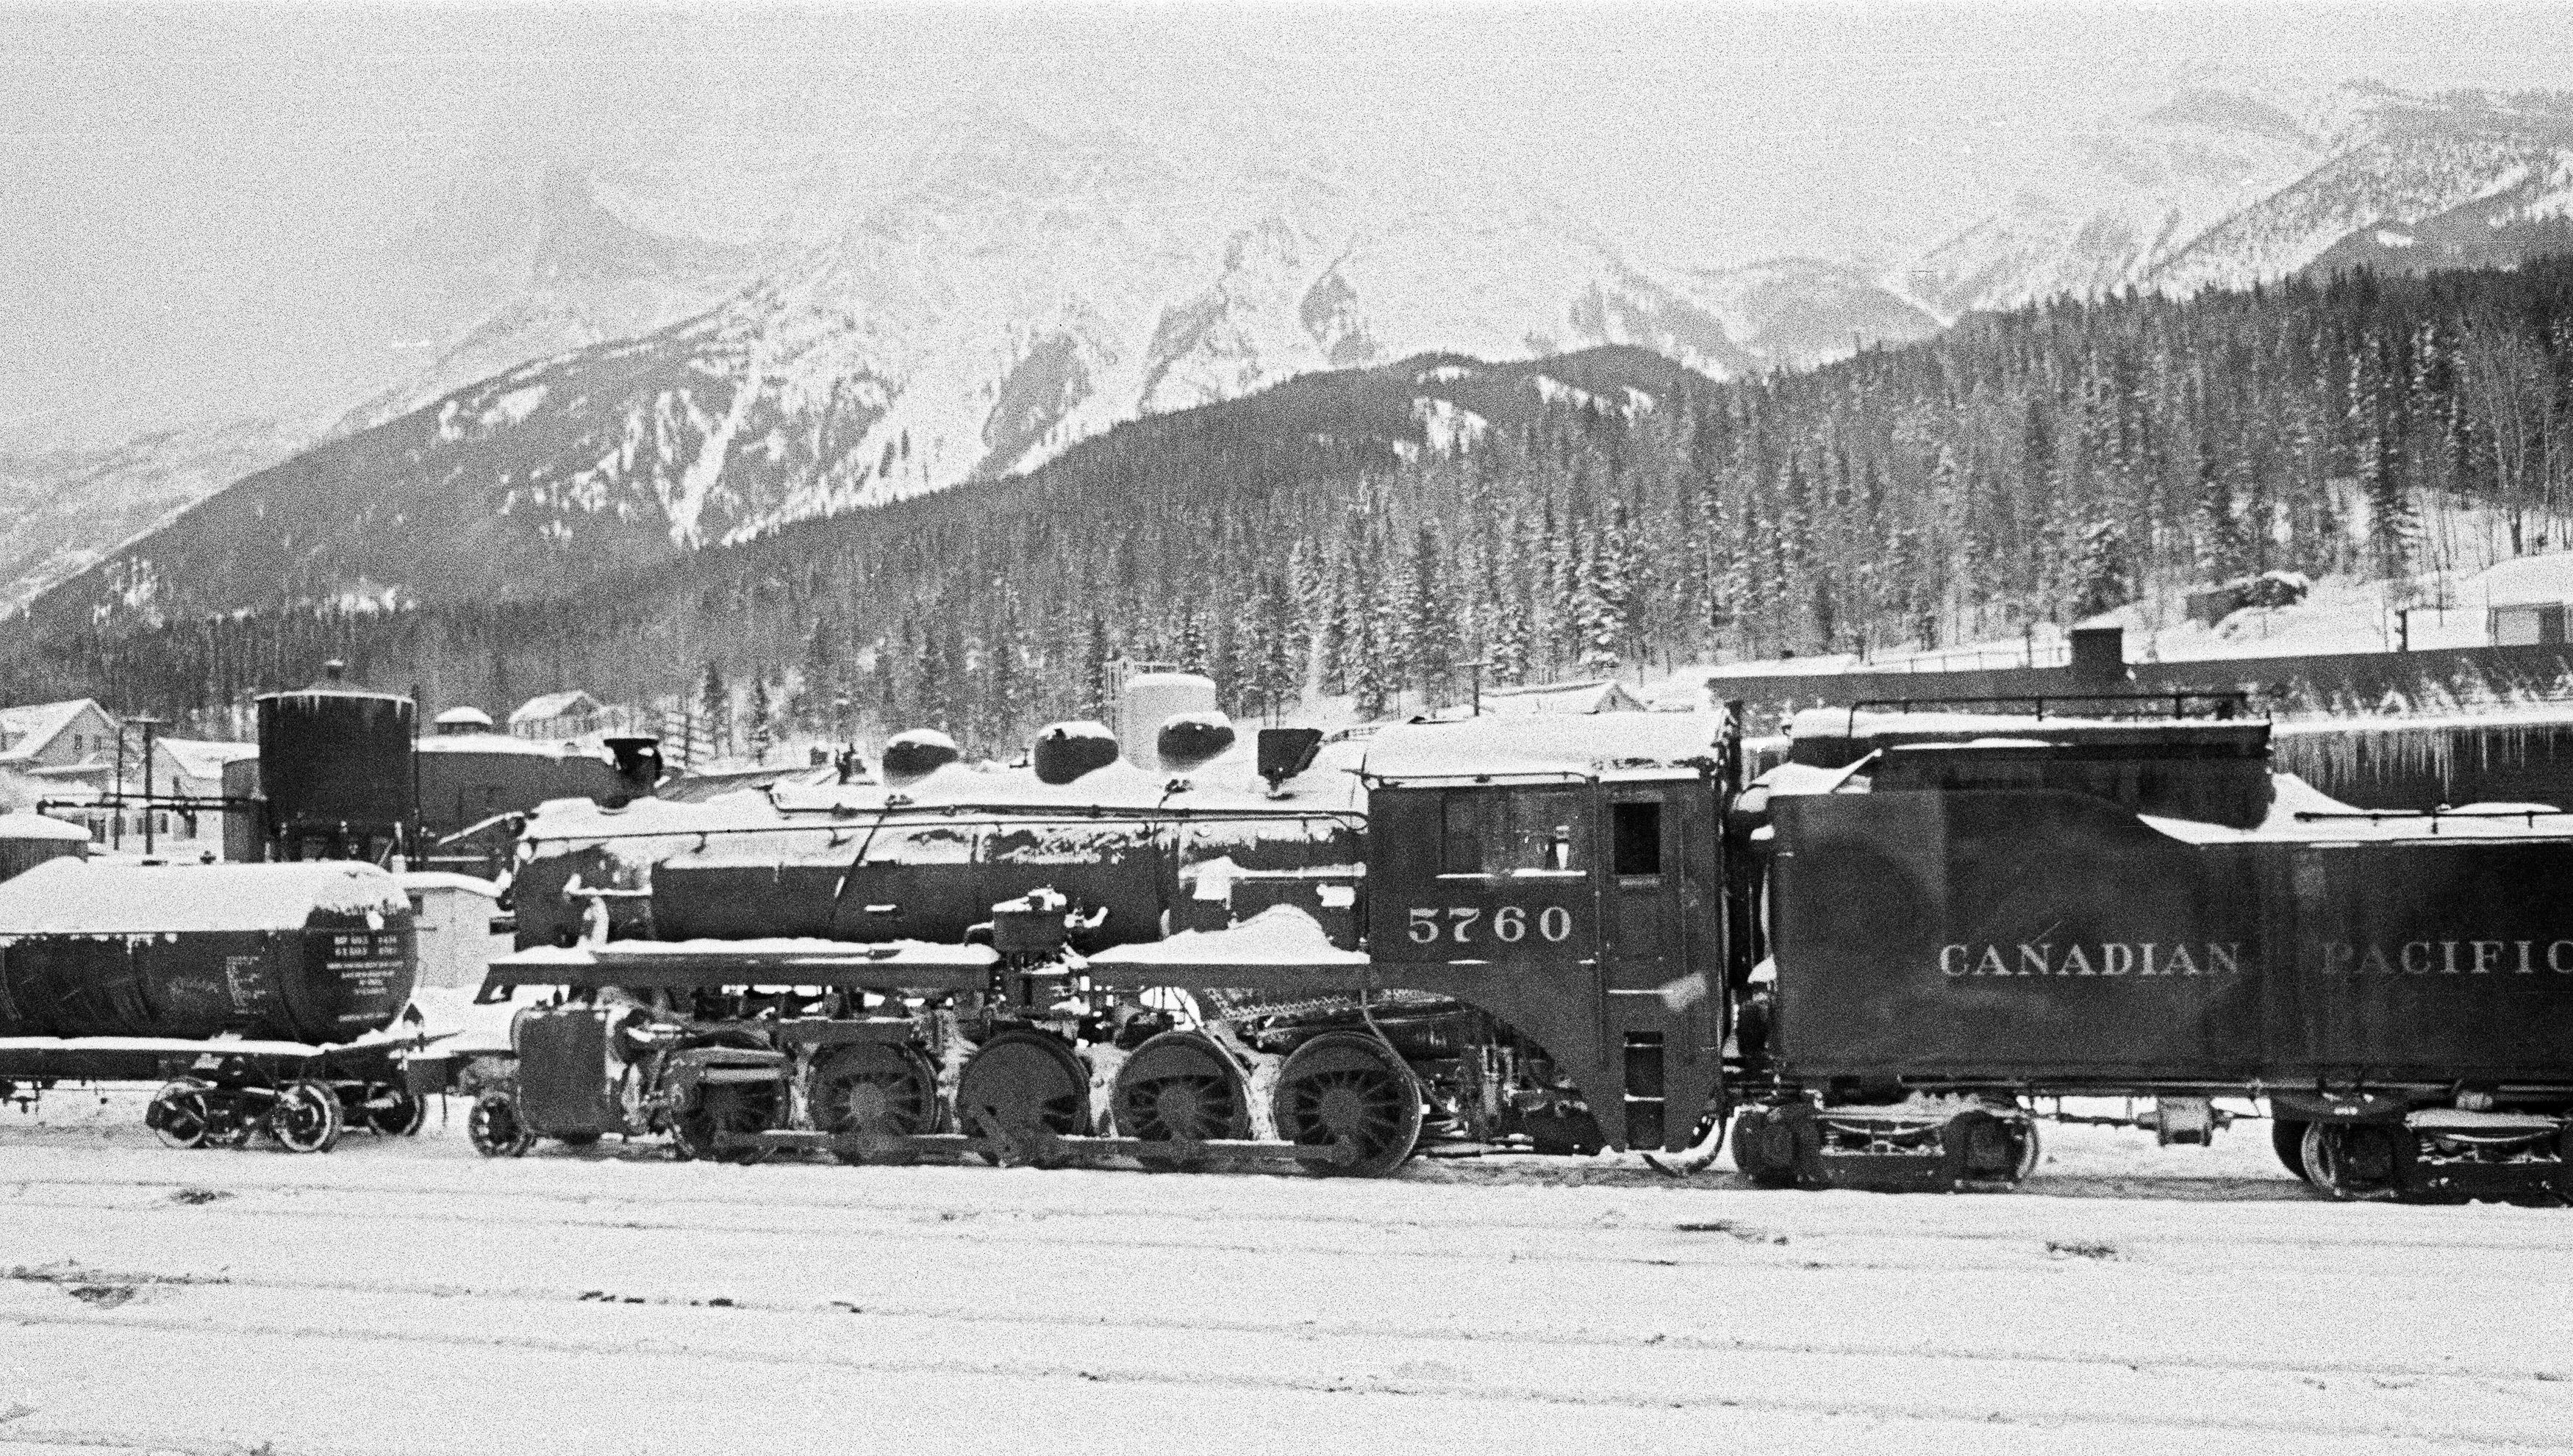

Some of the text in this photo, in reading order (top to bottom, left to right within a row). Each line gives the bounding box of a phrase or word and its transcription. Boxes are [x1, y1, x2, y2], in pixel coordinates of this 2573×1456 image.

[1409, 905, 1572, 944] 5760
[1938, 939, 2573, 976] CANADIAN PACIFIC
